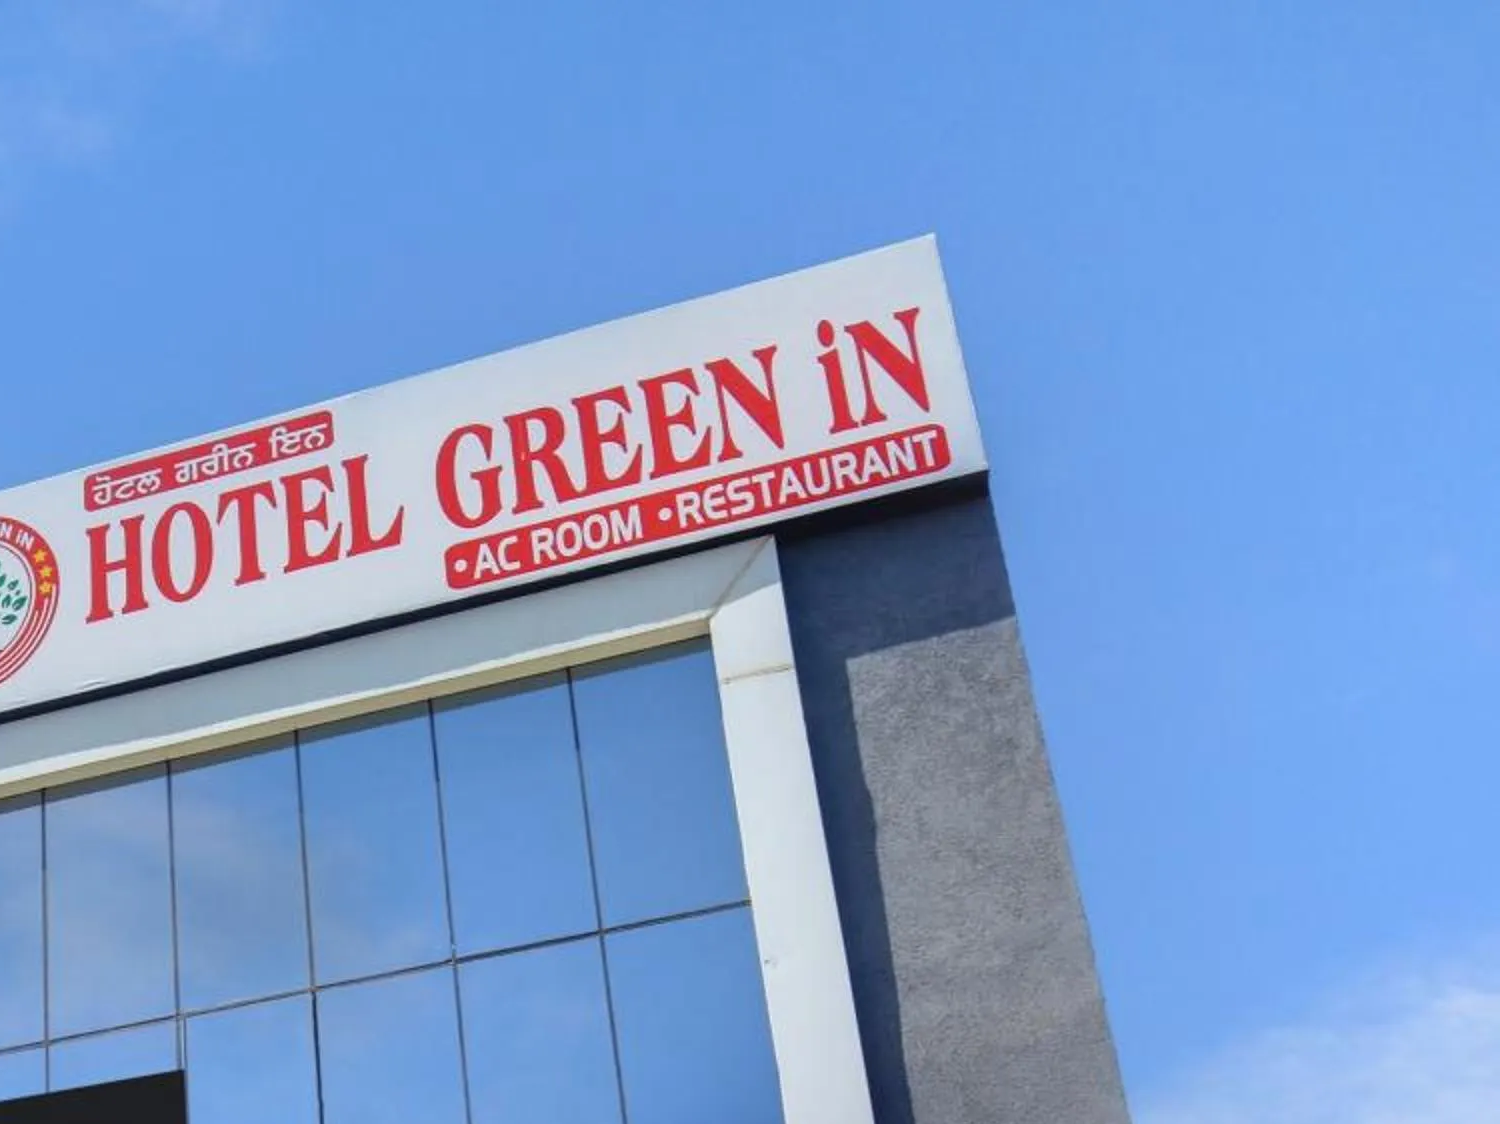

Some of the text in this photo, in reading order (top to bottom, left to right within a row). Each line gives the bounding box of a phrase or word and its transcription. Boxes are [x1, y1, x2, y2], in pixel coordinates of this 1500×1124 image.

[85, 454, 405, 624] HOTEL
[435, 344, 784, 529] GREEN
[91, 423, 328, 506] ਹੋਟਲ ਗਰੀਨ ਇਨ
[472, 428, 940, 579] AC ROOM RESTAURANT
